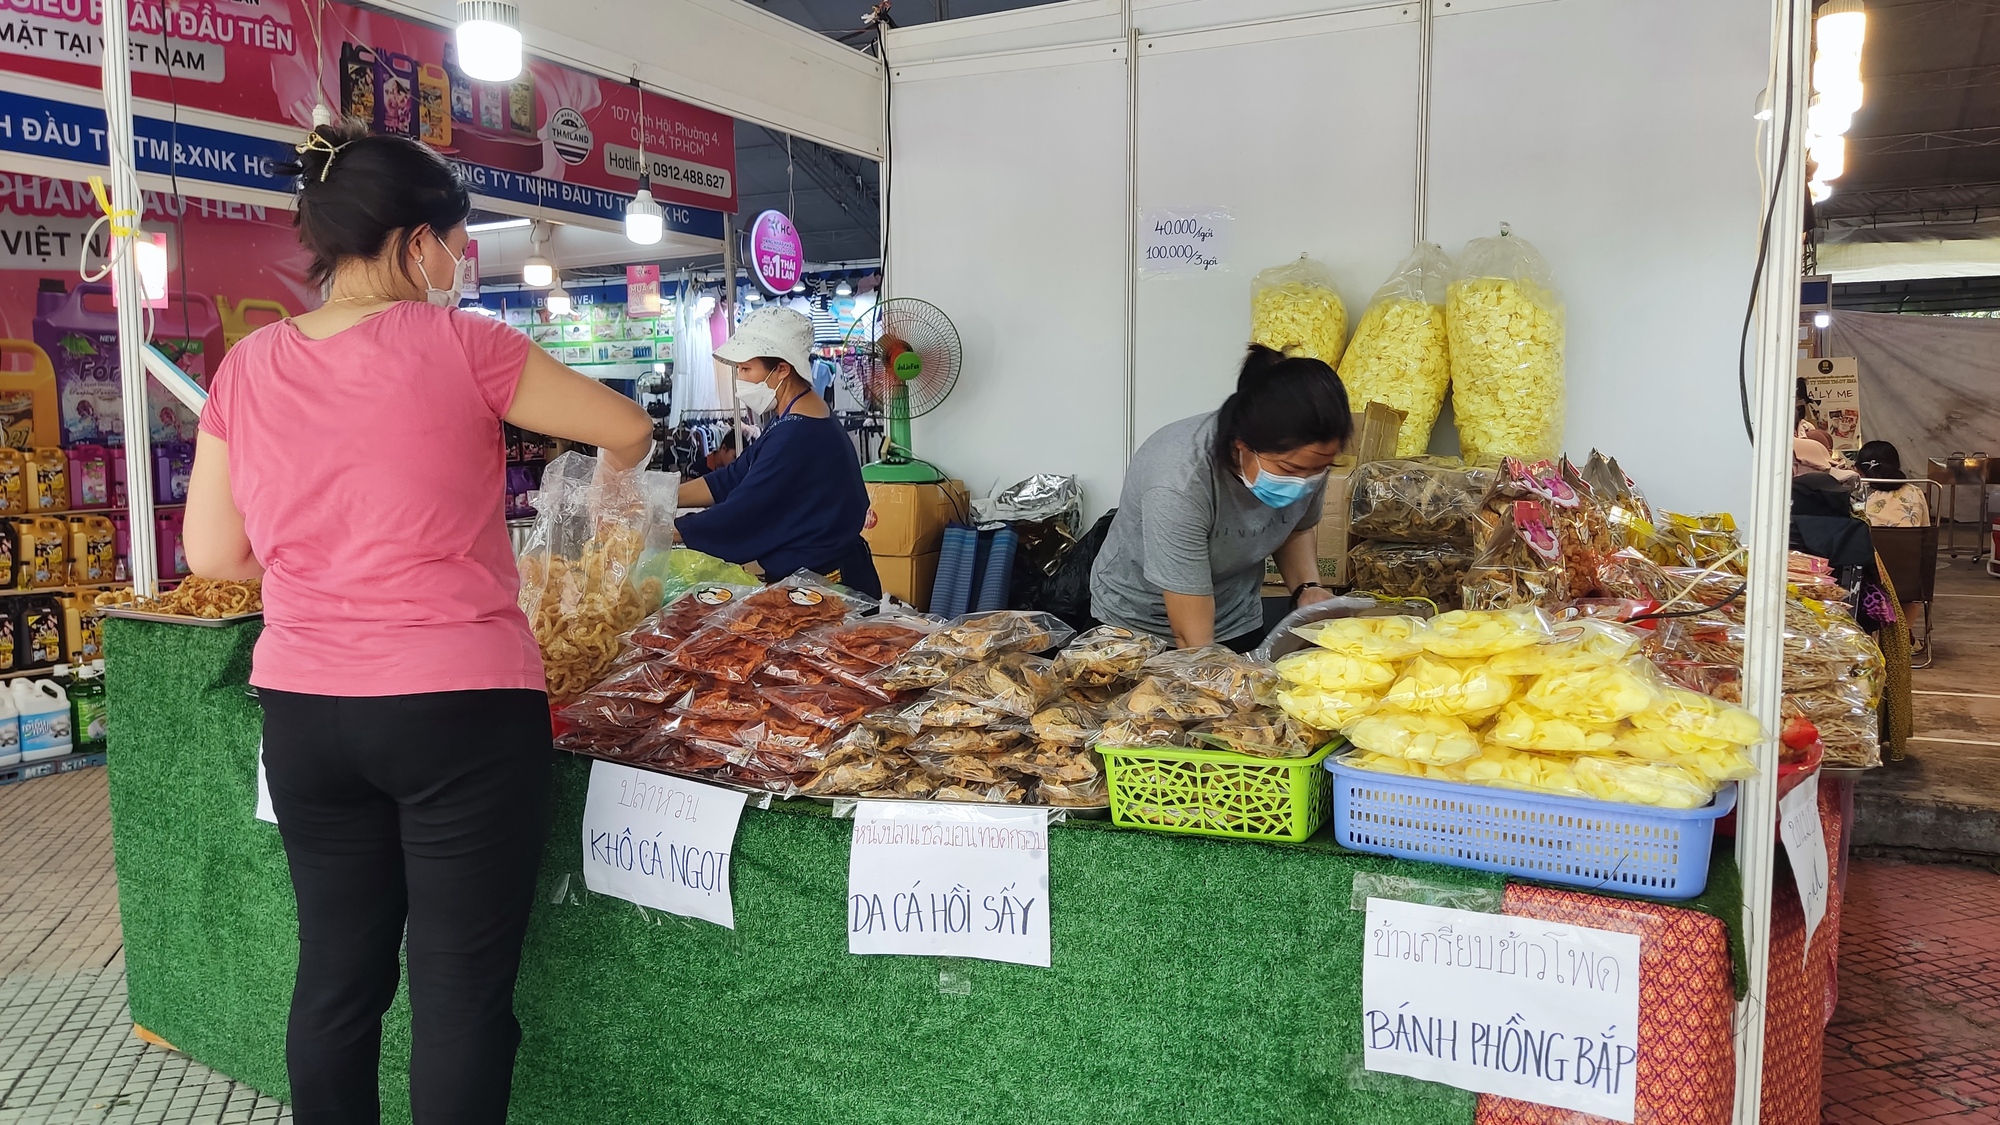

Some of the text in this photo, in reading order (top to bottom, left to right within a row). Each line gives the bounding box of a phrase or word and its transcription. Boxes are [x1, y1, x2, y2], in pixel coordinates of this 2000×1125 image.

[0, 19, 47, 50] MẶT
[54, 29, 92, 57] TẠI
[155, 47, 205, 71] NAM
[178, 3, 233, 41] ĐẦU
[239, 18, 293, 51] TIÊN
[22, 110, 81, 147] ĐẦU
[133, 136, 237, 173] TM&XNK
[244, 155, 275, 178] HC
[552, 127, 589, 144] THAILAND
[611, 105, 720, 147] 107 Vnh Hội, Phường 4,
[658, 134, 668, 149] 4,
[669, 136, 705, 156] TP.HCM
[653, 161, 725, 190] 0912.488.627
[490, 170, 510, 190] TY
[515, 175, 557, 199] TNHH
[561, 180, 592, 206] ĐẦU
[594, 192, 614, 210] TƯ
[673, 206, 690, 224] HC
[1, 225, 71, 262] VIỆT
[772, 254, 781, 279] 1
[780, 258, 796, 271] THÁI
[781, 269, 795, 281] LAN
[100, 334, 116, 343] NEW
[1819, 389, 1832, 399] LY
[1837, 390, 1853, 399] ME
[591, 827, 730, 897] KHÔ CÁ NGỌT
[850, 880, 1036, 935] DA CÁ HỒI SẤY
[1365, 1001, 1637, 1095] BÁNH PHỒNG BẮP
